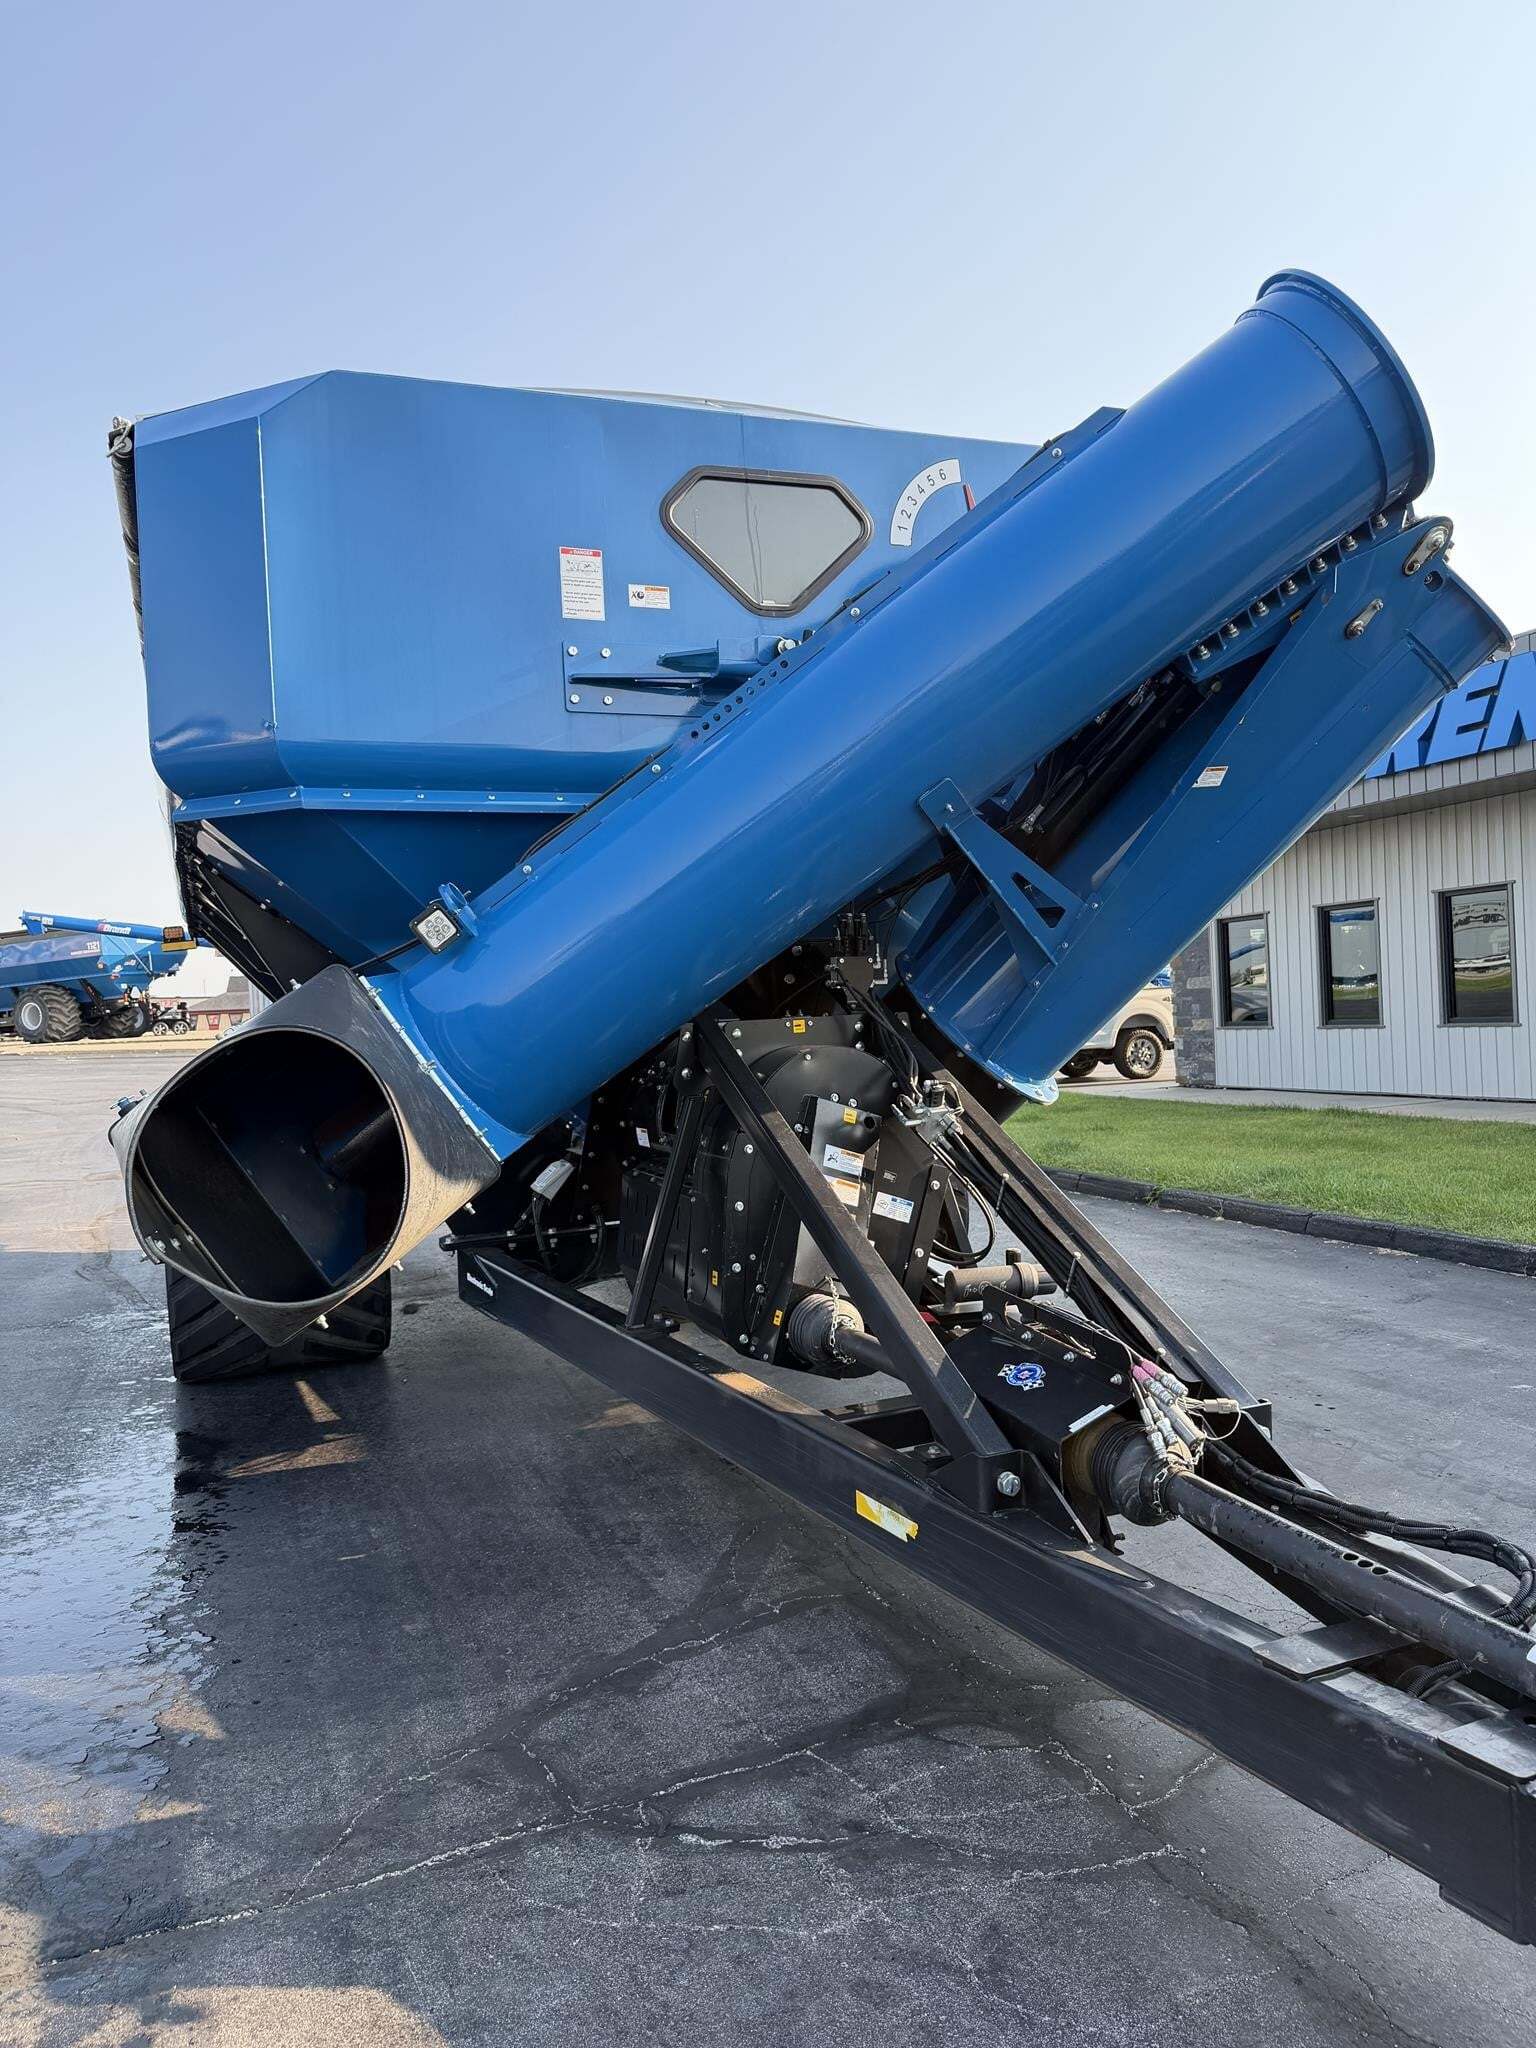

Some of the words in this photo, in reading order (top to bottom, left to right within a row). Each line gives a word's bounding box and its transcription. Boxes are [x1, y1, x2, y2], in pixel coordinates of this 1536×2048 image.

[901, 509, 911, 519] 2
[908, 496, 917, 506] 3
[917, 484, 926, 495] 4
[926, 474, 935, 487] 5
[938, 468, 947, 481] 6
